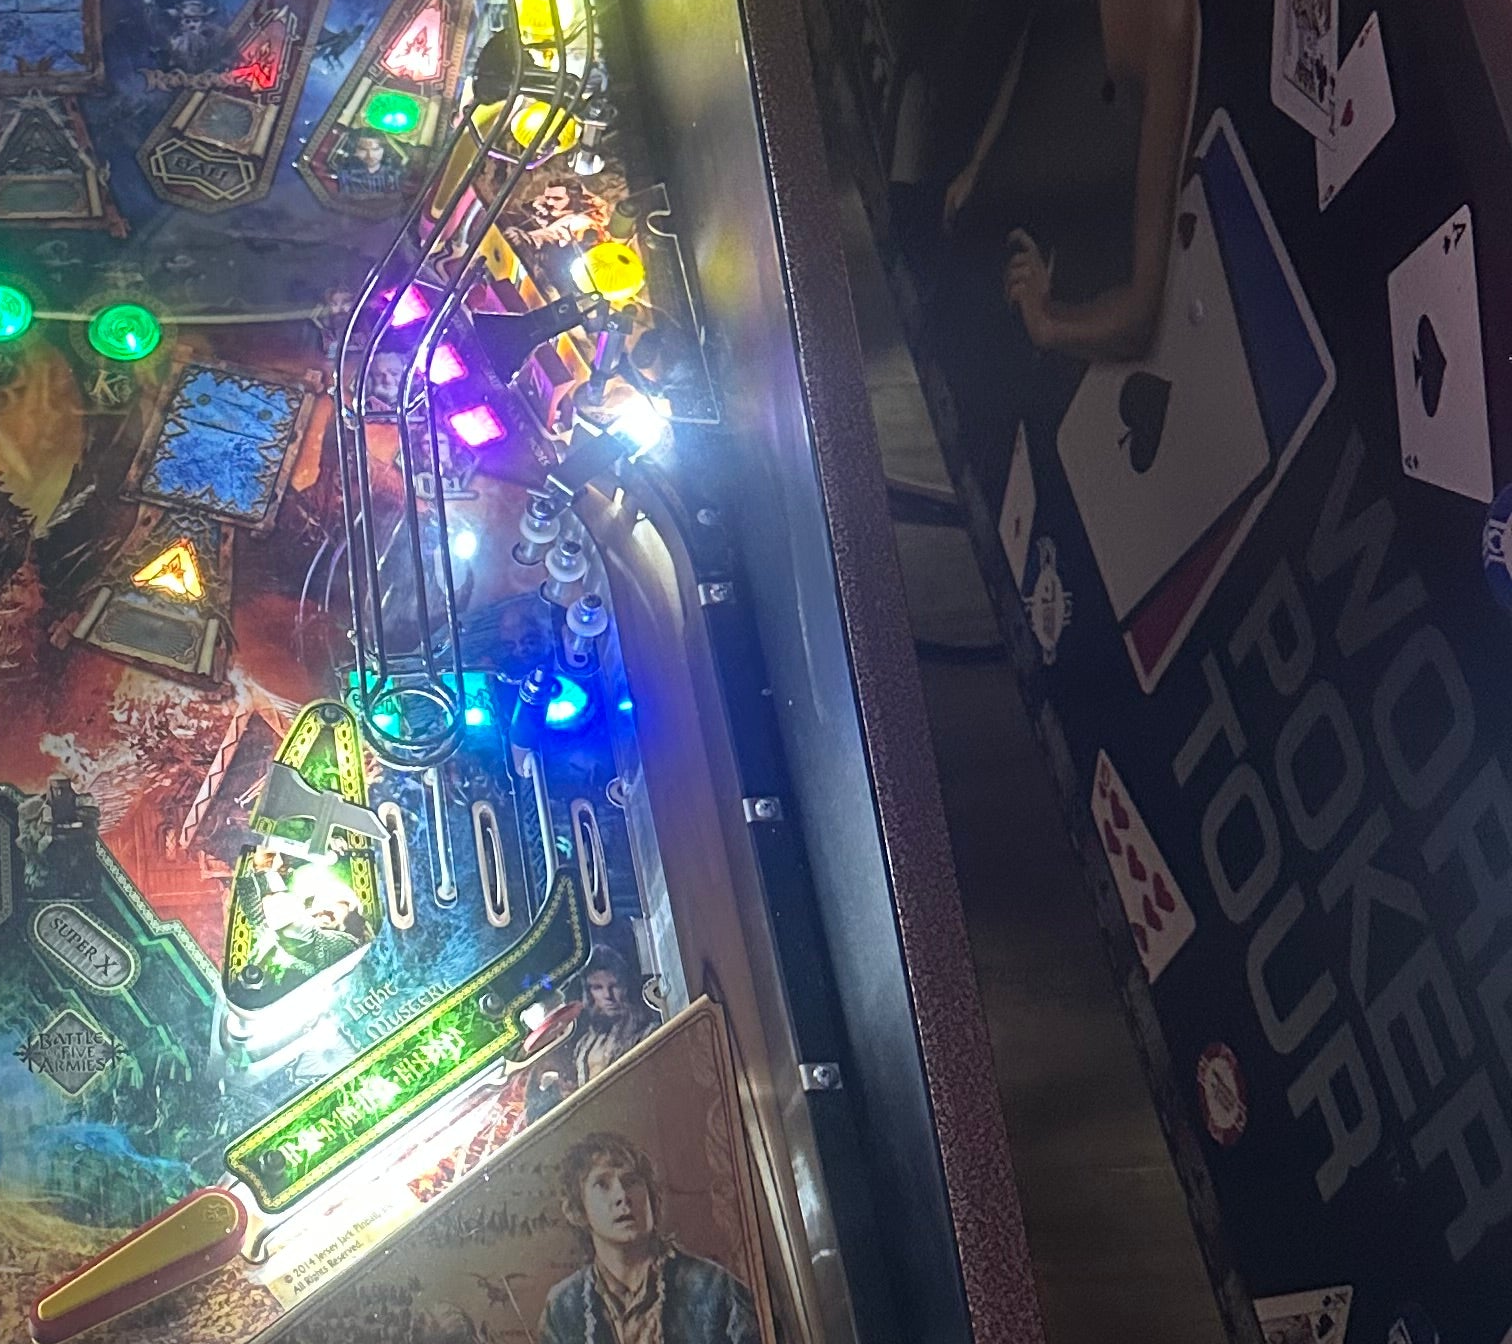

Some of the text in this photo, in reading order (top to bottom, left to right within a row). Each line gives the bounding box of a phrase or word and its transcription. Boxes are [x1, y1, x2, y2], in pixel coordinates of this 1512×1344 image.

[90, 369, 119, 405] K
[1172, 648, 1383, 1204] TOUR
[1228, 559, 1512, 1262] POKER
[49, 917, 119, 976] SUPER X
[39, 1031, 104, 1050] BATTLE
[61, 1045, 96, 1060] FIVE
[38, 1057, 107, 1074] ARMIES
[292, 1257, 316, 1278] 2014
[316, 1242, 339, 1263] Jersey
[337, 1229, 355, 1248] Jack
[293, 1282, 306, 1296] All
[304, 1265, 330, 1285] Rights
